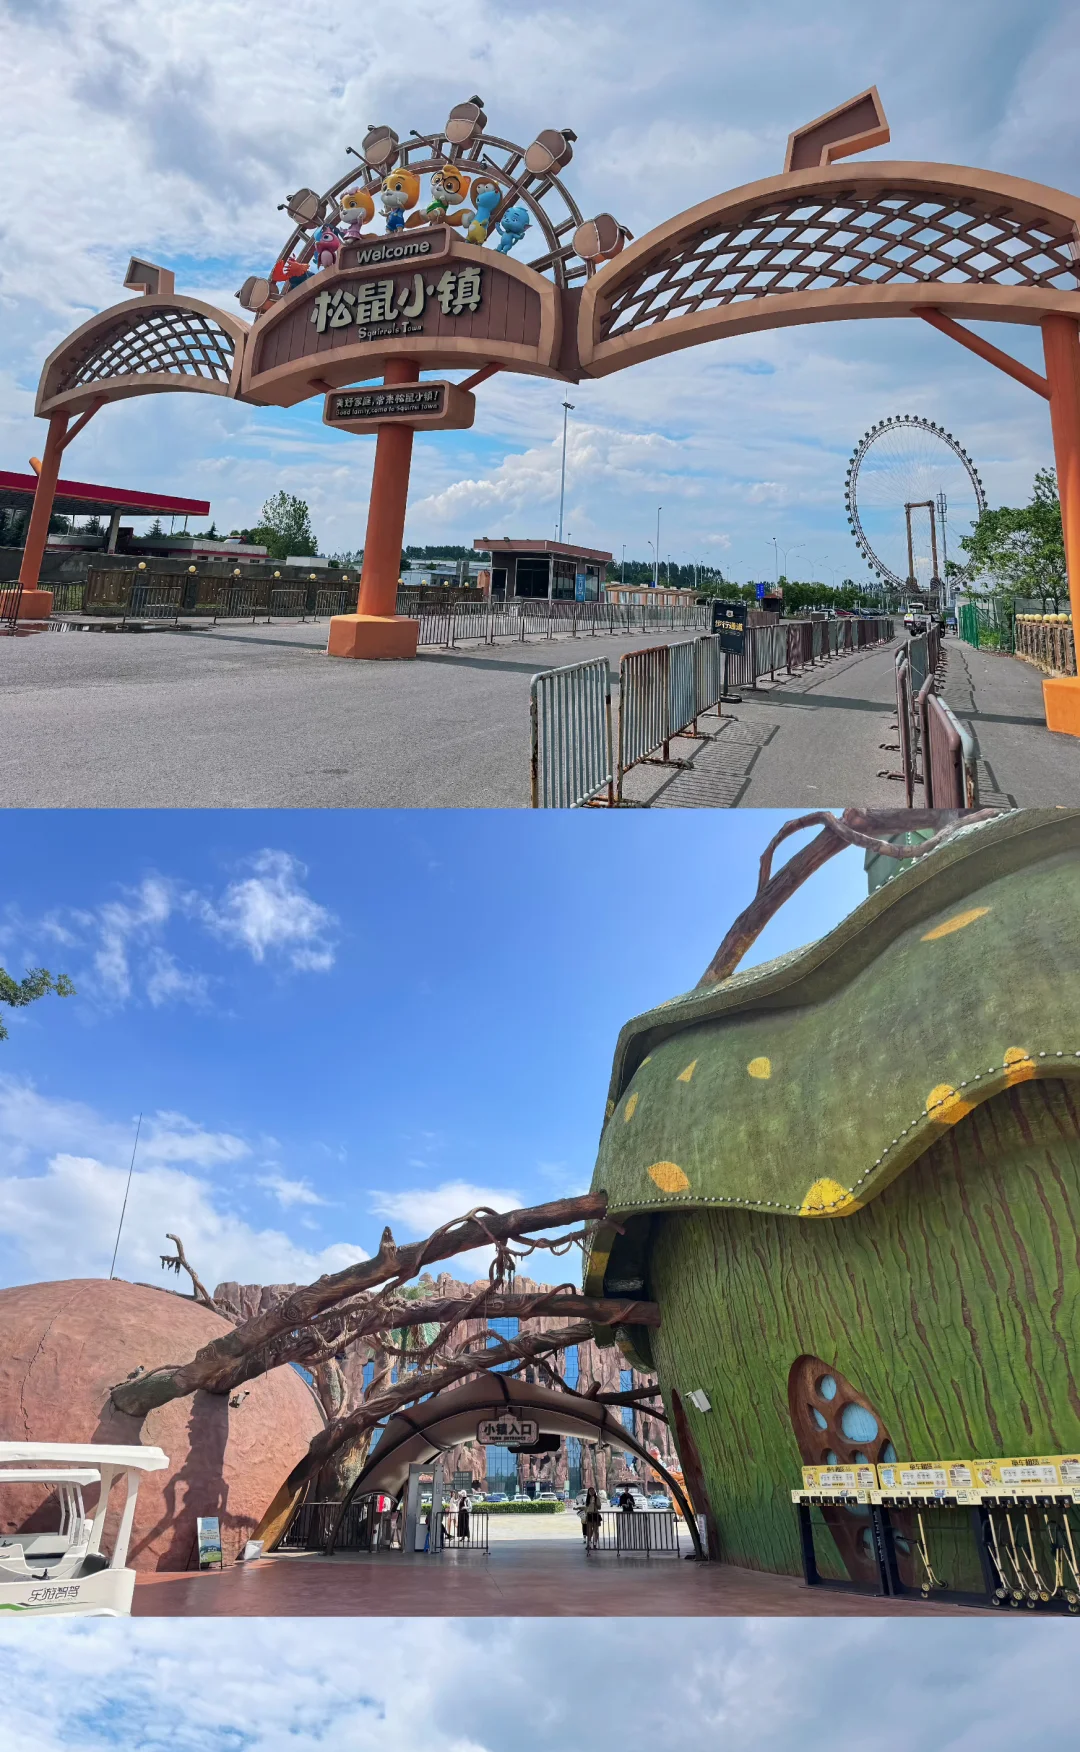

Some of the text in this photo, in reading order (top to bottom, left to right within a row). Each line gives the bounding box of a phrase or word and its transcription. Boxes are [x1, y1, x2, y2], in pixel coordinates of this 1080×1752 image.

[357, 241, 430, 264] Welcome
[310, 267, 481, 333] 松鼠小镇
[484, 1423, 532, 1436] 小镇入口
